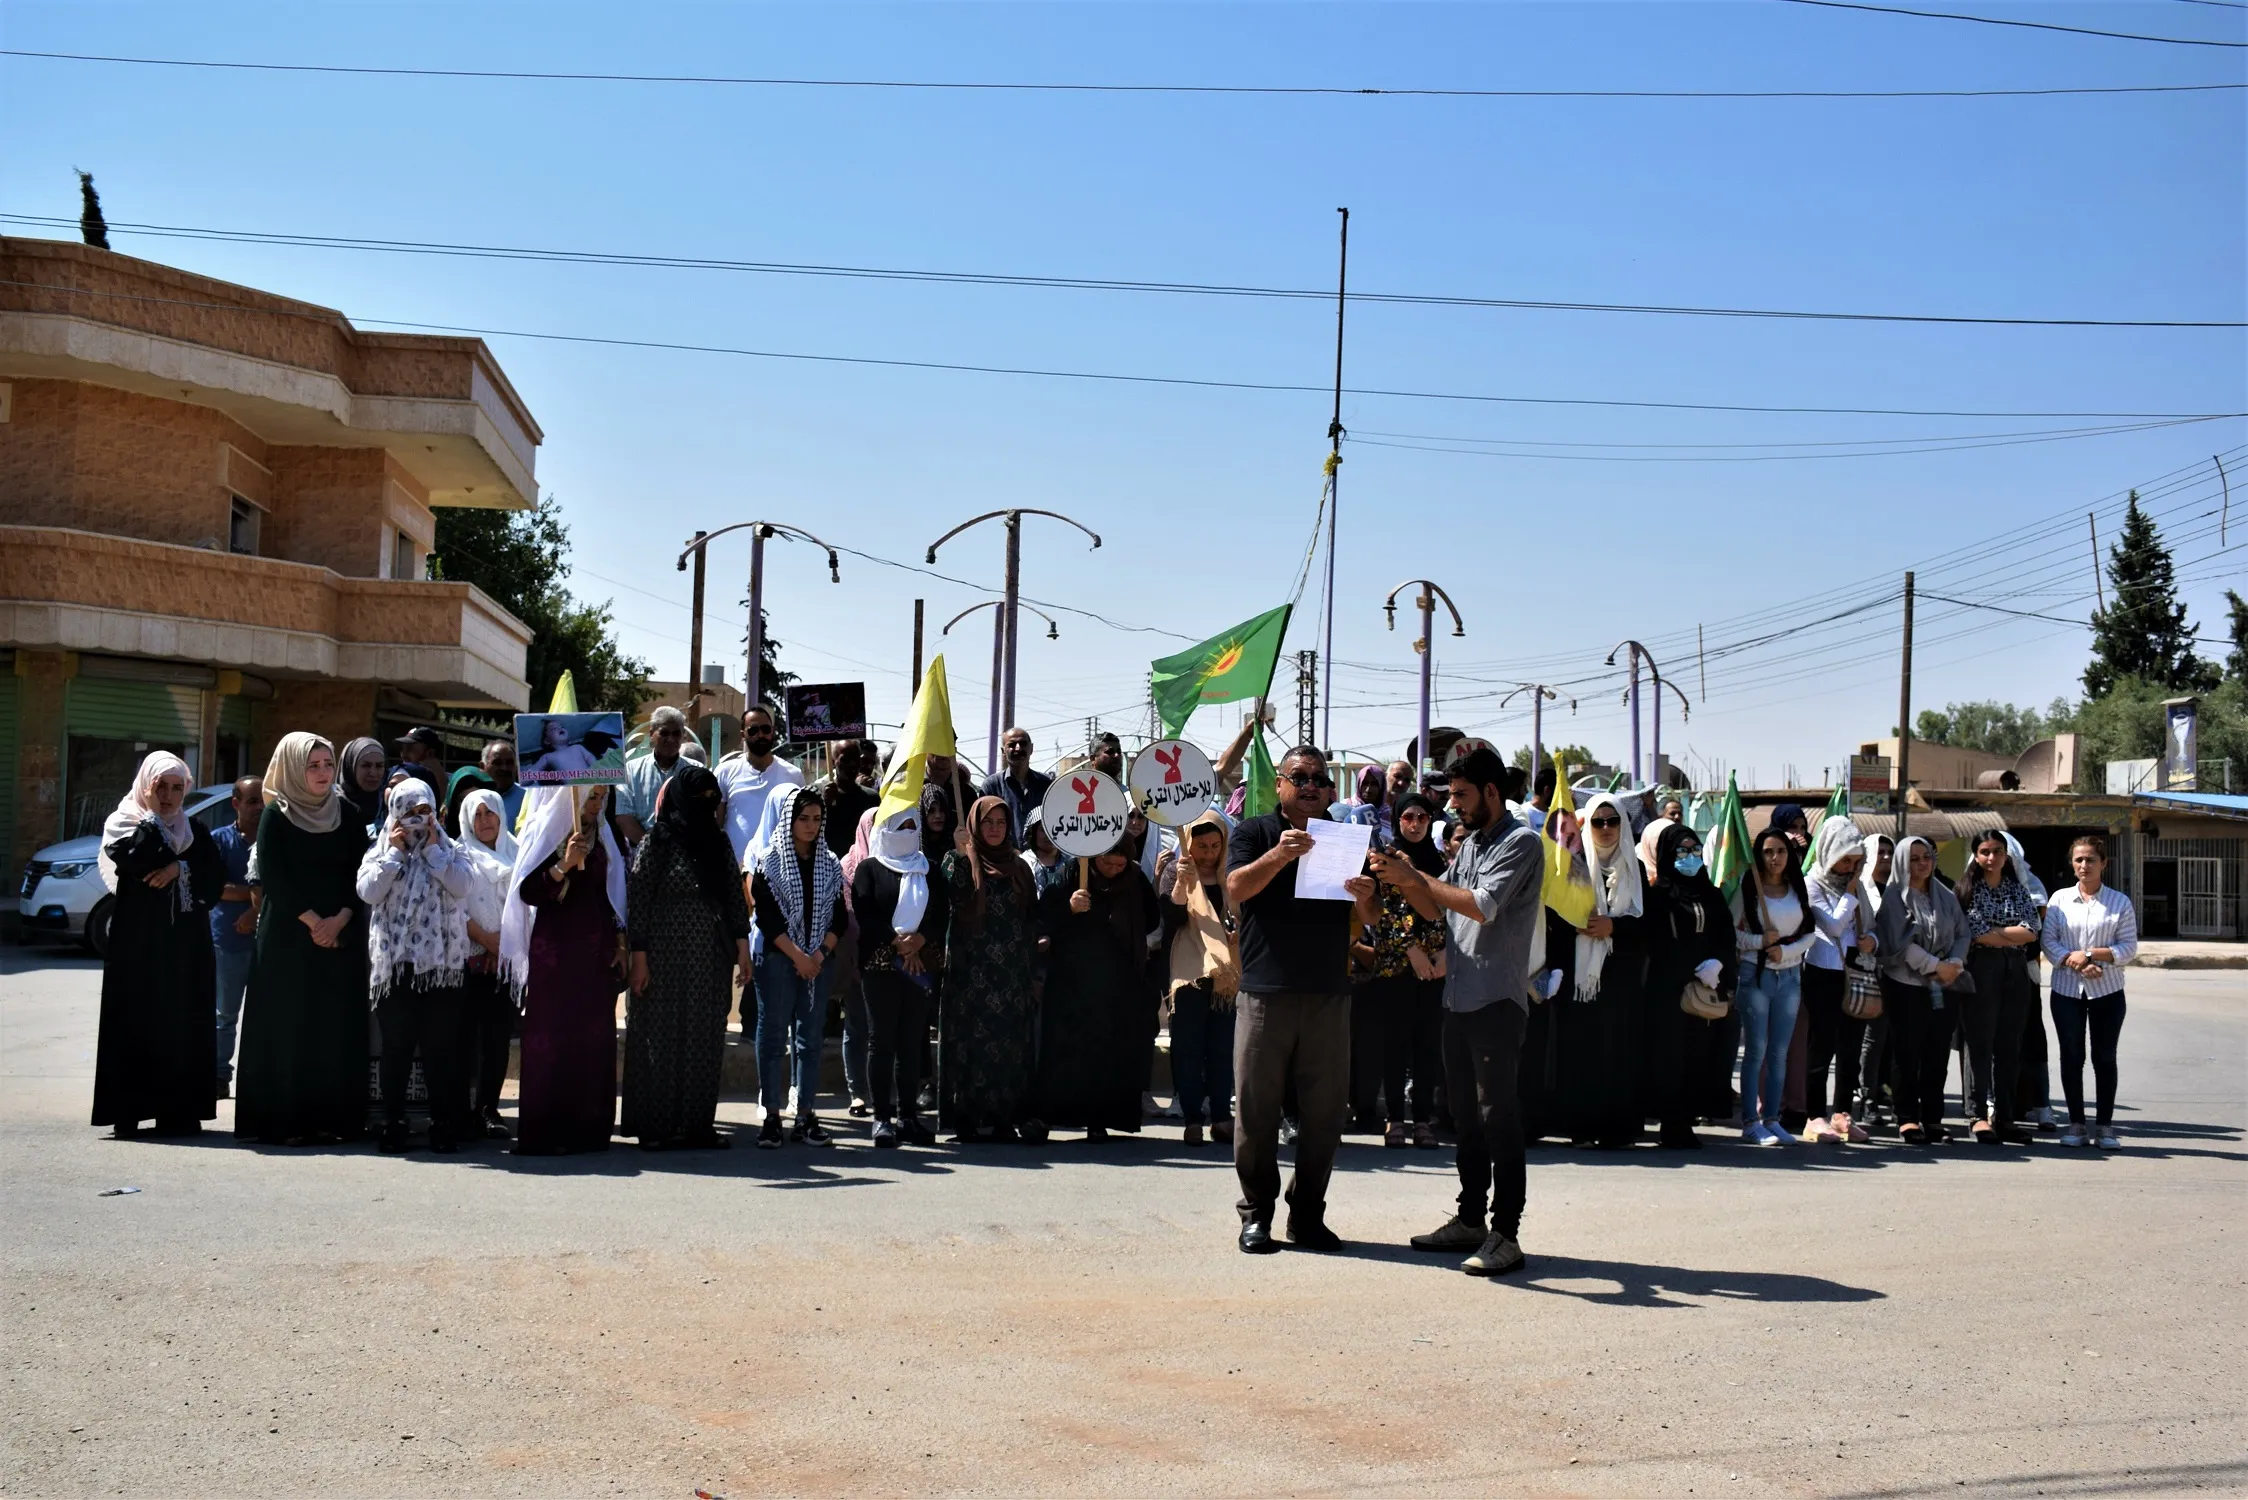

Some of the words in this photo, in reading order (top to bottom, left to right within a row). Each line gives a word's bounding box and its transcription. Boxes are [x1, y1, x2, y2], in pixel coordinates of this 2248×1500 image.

[568, 770, 582, 778] ME
[1155, 744, 1183, 785] لا
[1071, 775, 1100, 814] لا
[1140, 787, 1172, 814] التركي
[1051, 814, 1083, 840] التركي
